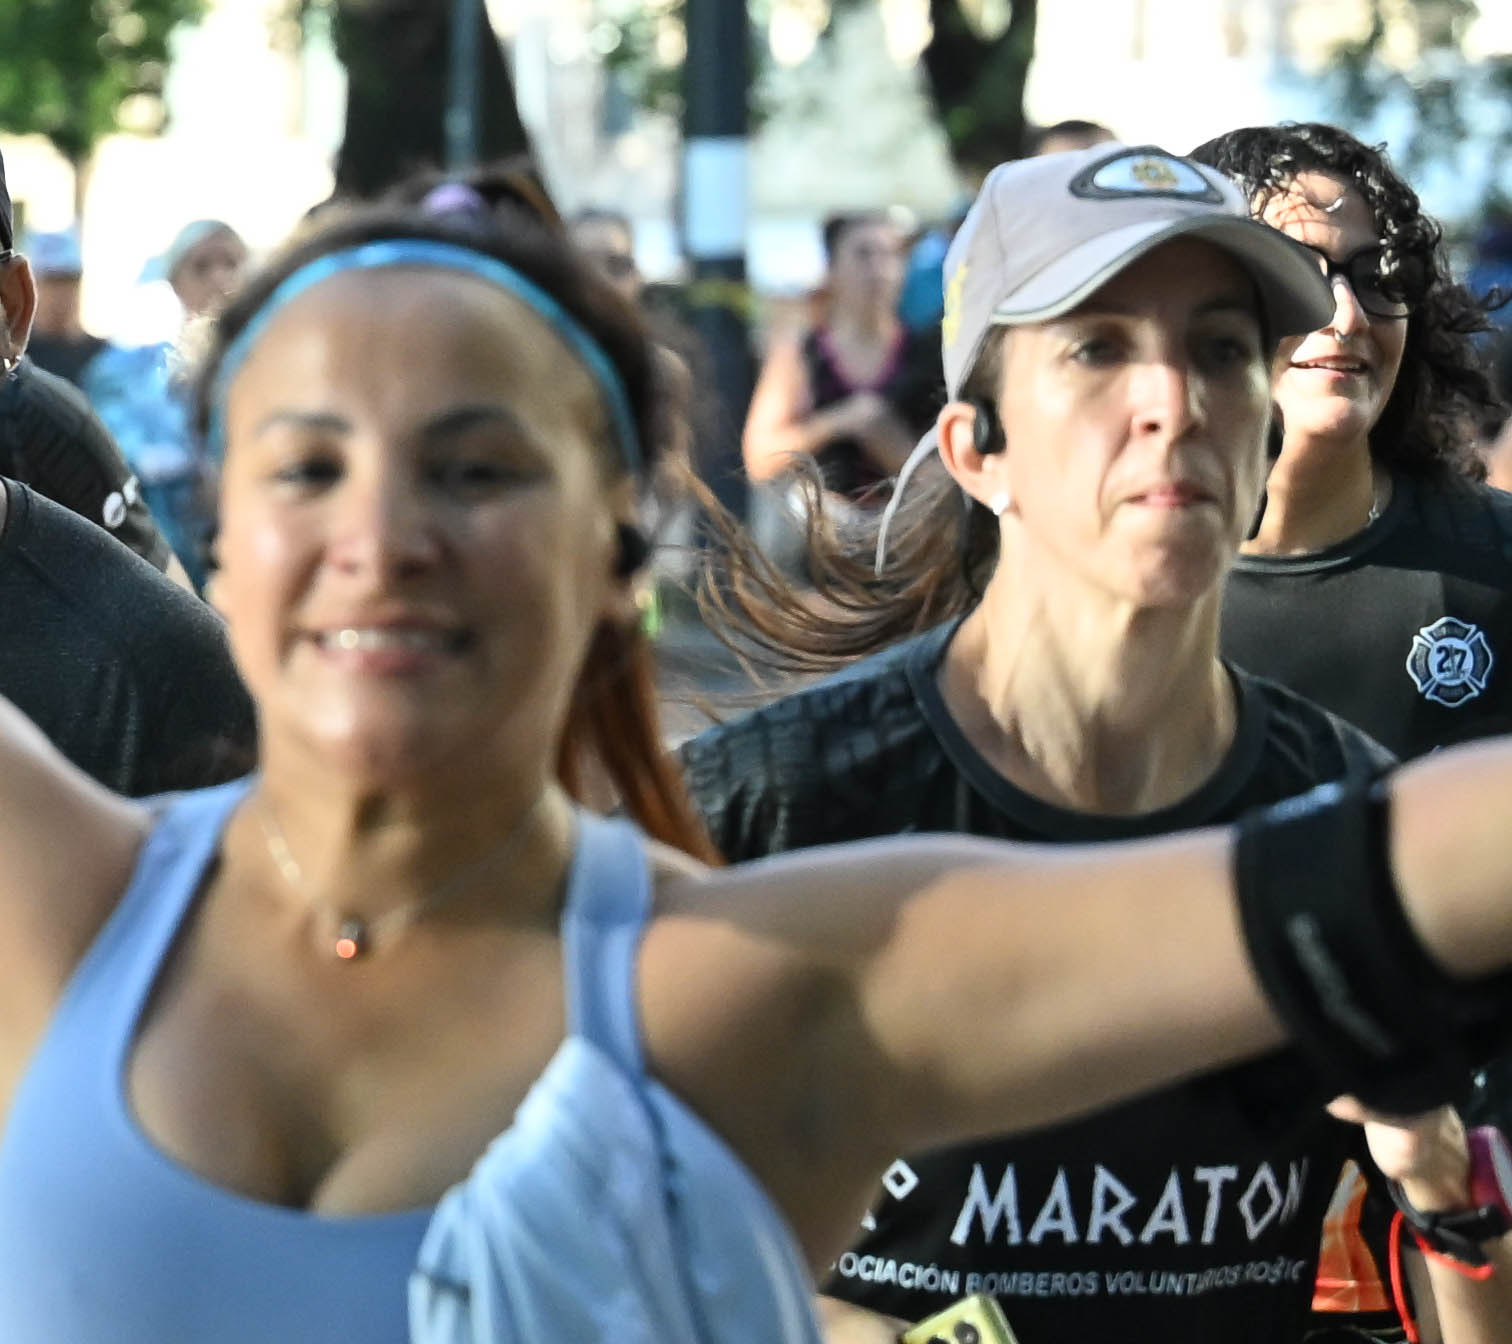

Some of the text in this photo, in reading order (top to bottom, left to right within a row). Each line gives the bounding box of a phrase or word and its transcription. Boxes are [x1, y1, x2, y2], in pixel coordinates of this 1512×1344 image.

[1436, 644, 1468, 674] 27
[838, 1251, 960, 1296] OCIACIÓN
[965, 1269, 1097, 1298] BOMBEROS
